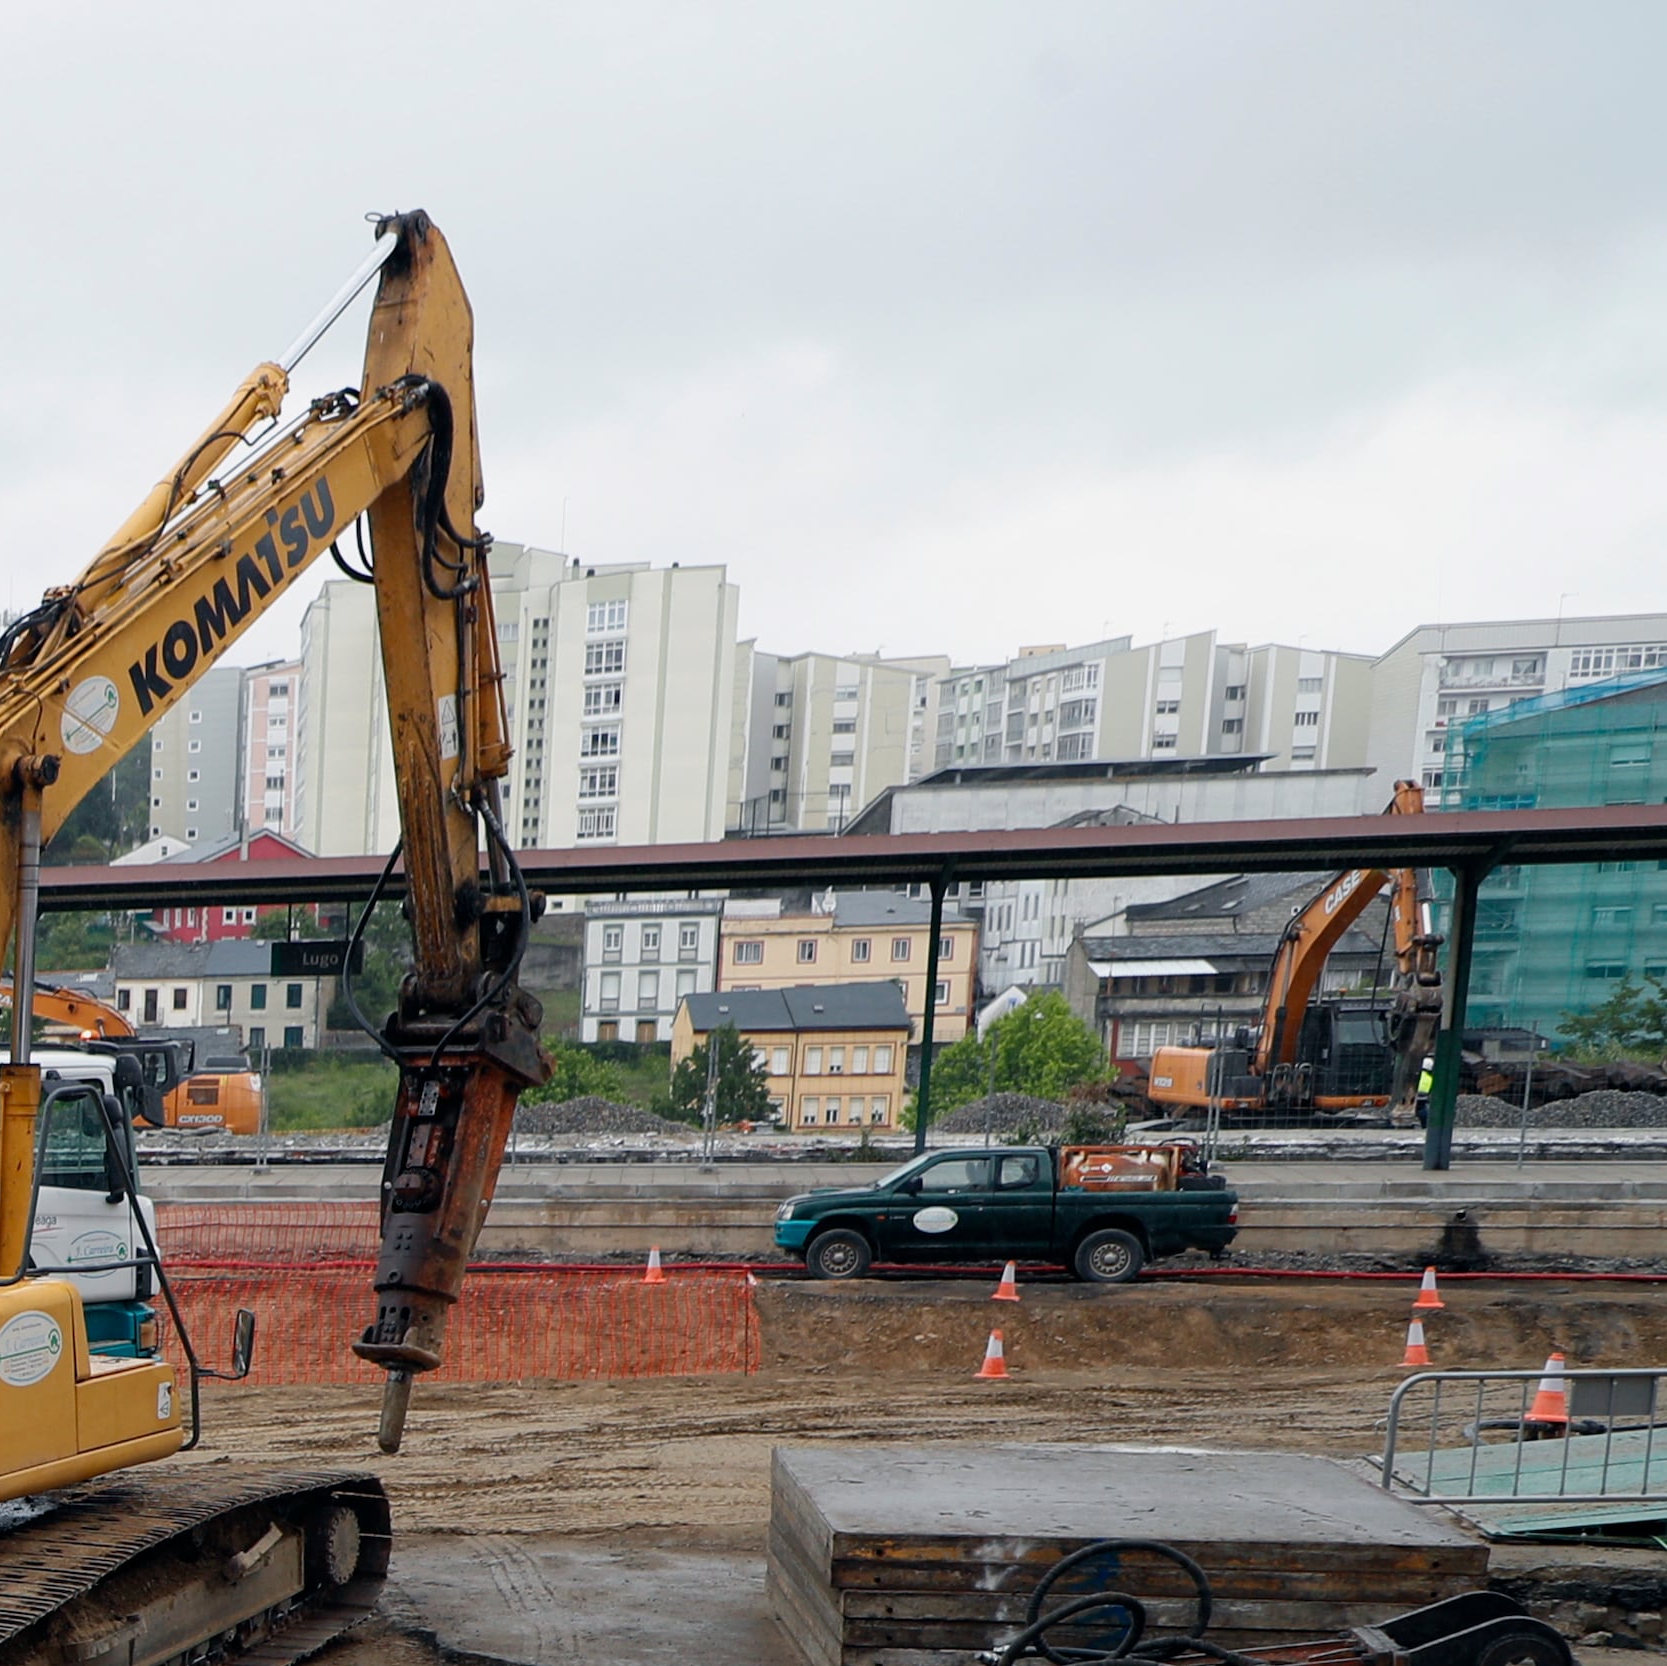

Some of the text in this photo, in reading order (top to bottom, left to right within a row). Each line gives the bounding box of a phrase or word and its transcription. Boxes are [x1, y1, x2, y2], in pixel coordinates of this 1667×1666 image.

[128, 475, 335, 717] KOMATSU
[1325, 869, 1361, 915] CASE
[303, 952, 338, 968] Lugo
